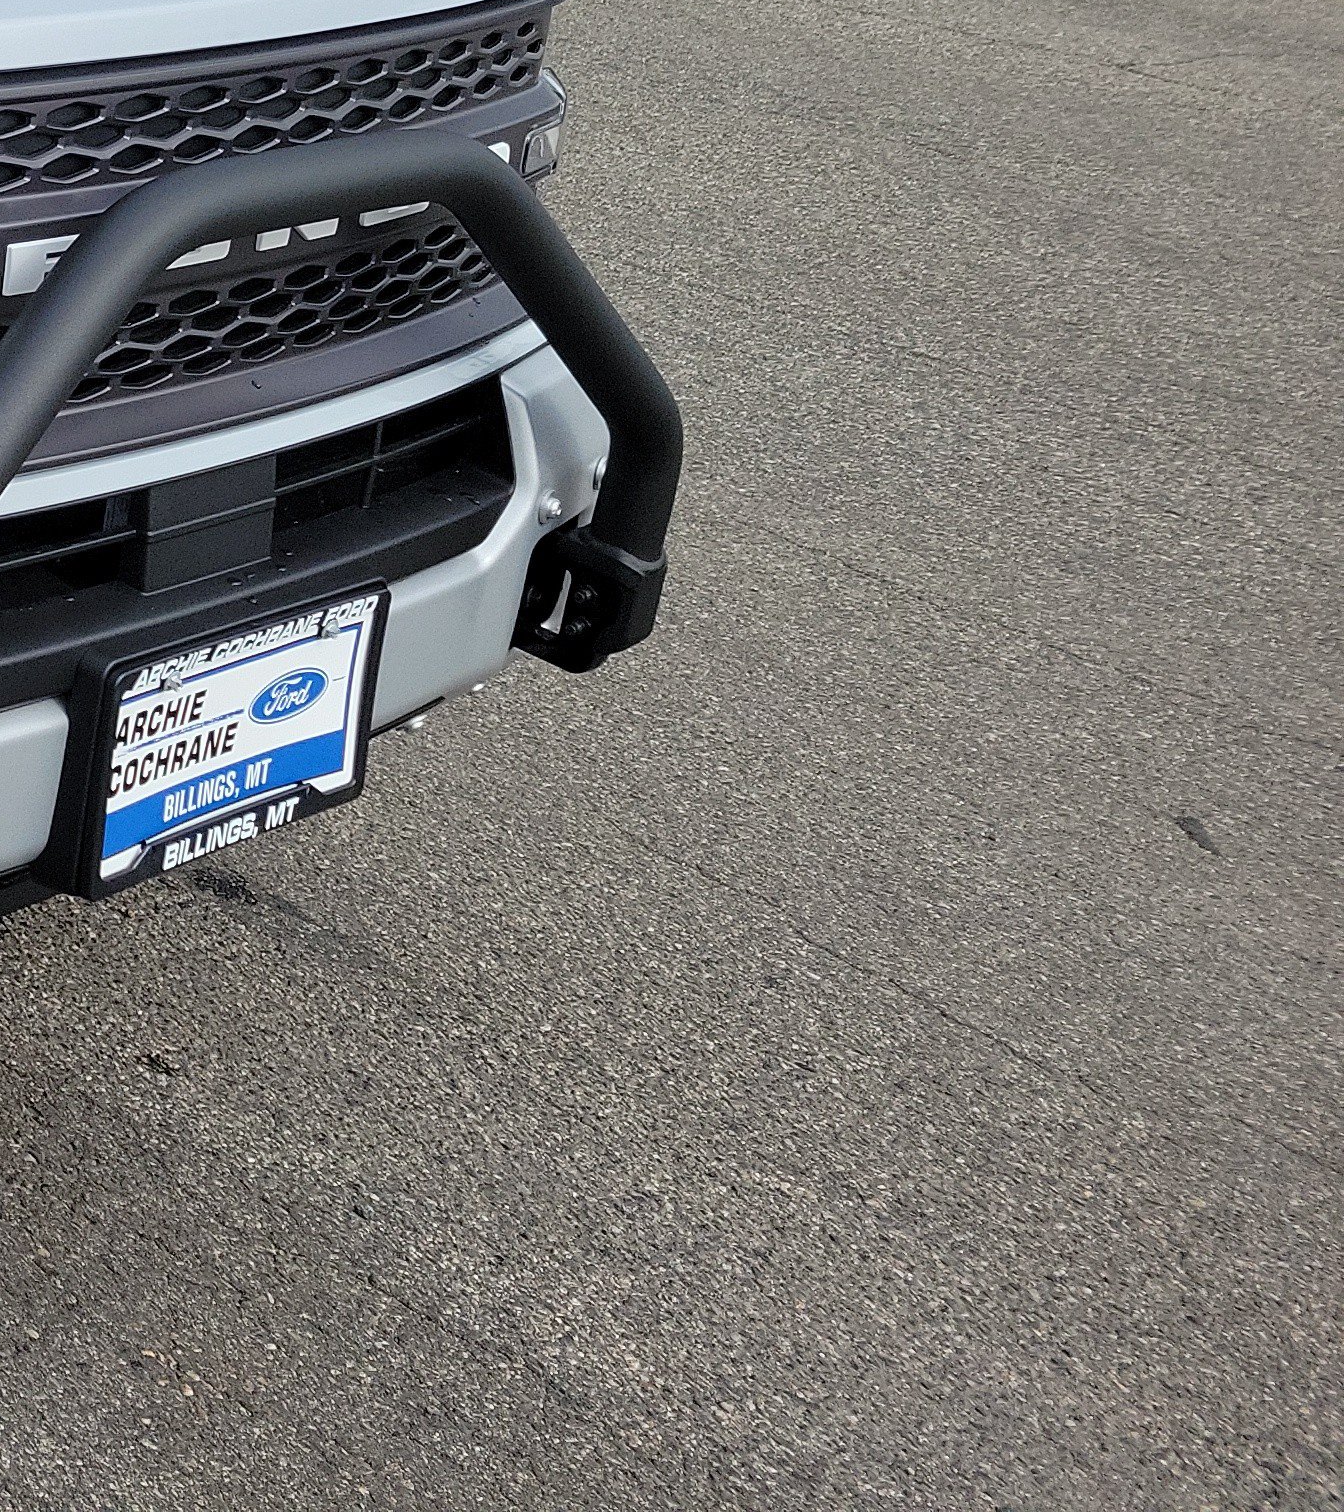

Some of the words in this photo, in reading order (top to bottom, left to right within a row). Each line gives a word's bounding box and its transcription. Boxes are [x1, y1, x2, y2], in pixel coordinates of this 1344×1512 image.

[130, 647, 212, 691] ARCHIE
[209, 610, 324, 662] COCHRANE
[320, 595, 379, 631] FORD
[115, 689, 208, 748] ARCHIE
[263, 676, 313, 716] Ford
[109, 721, 240, 798] COCHRANE
[163, 771, 241, 823] BILLINGS,
[244, 758, 273, 790] MT
[163, 812, 260, 871] BILLINGS,
[264, 796, 300, 831] MT
